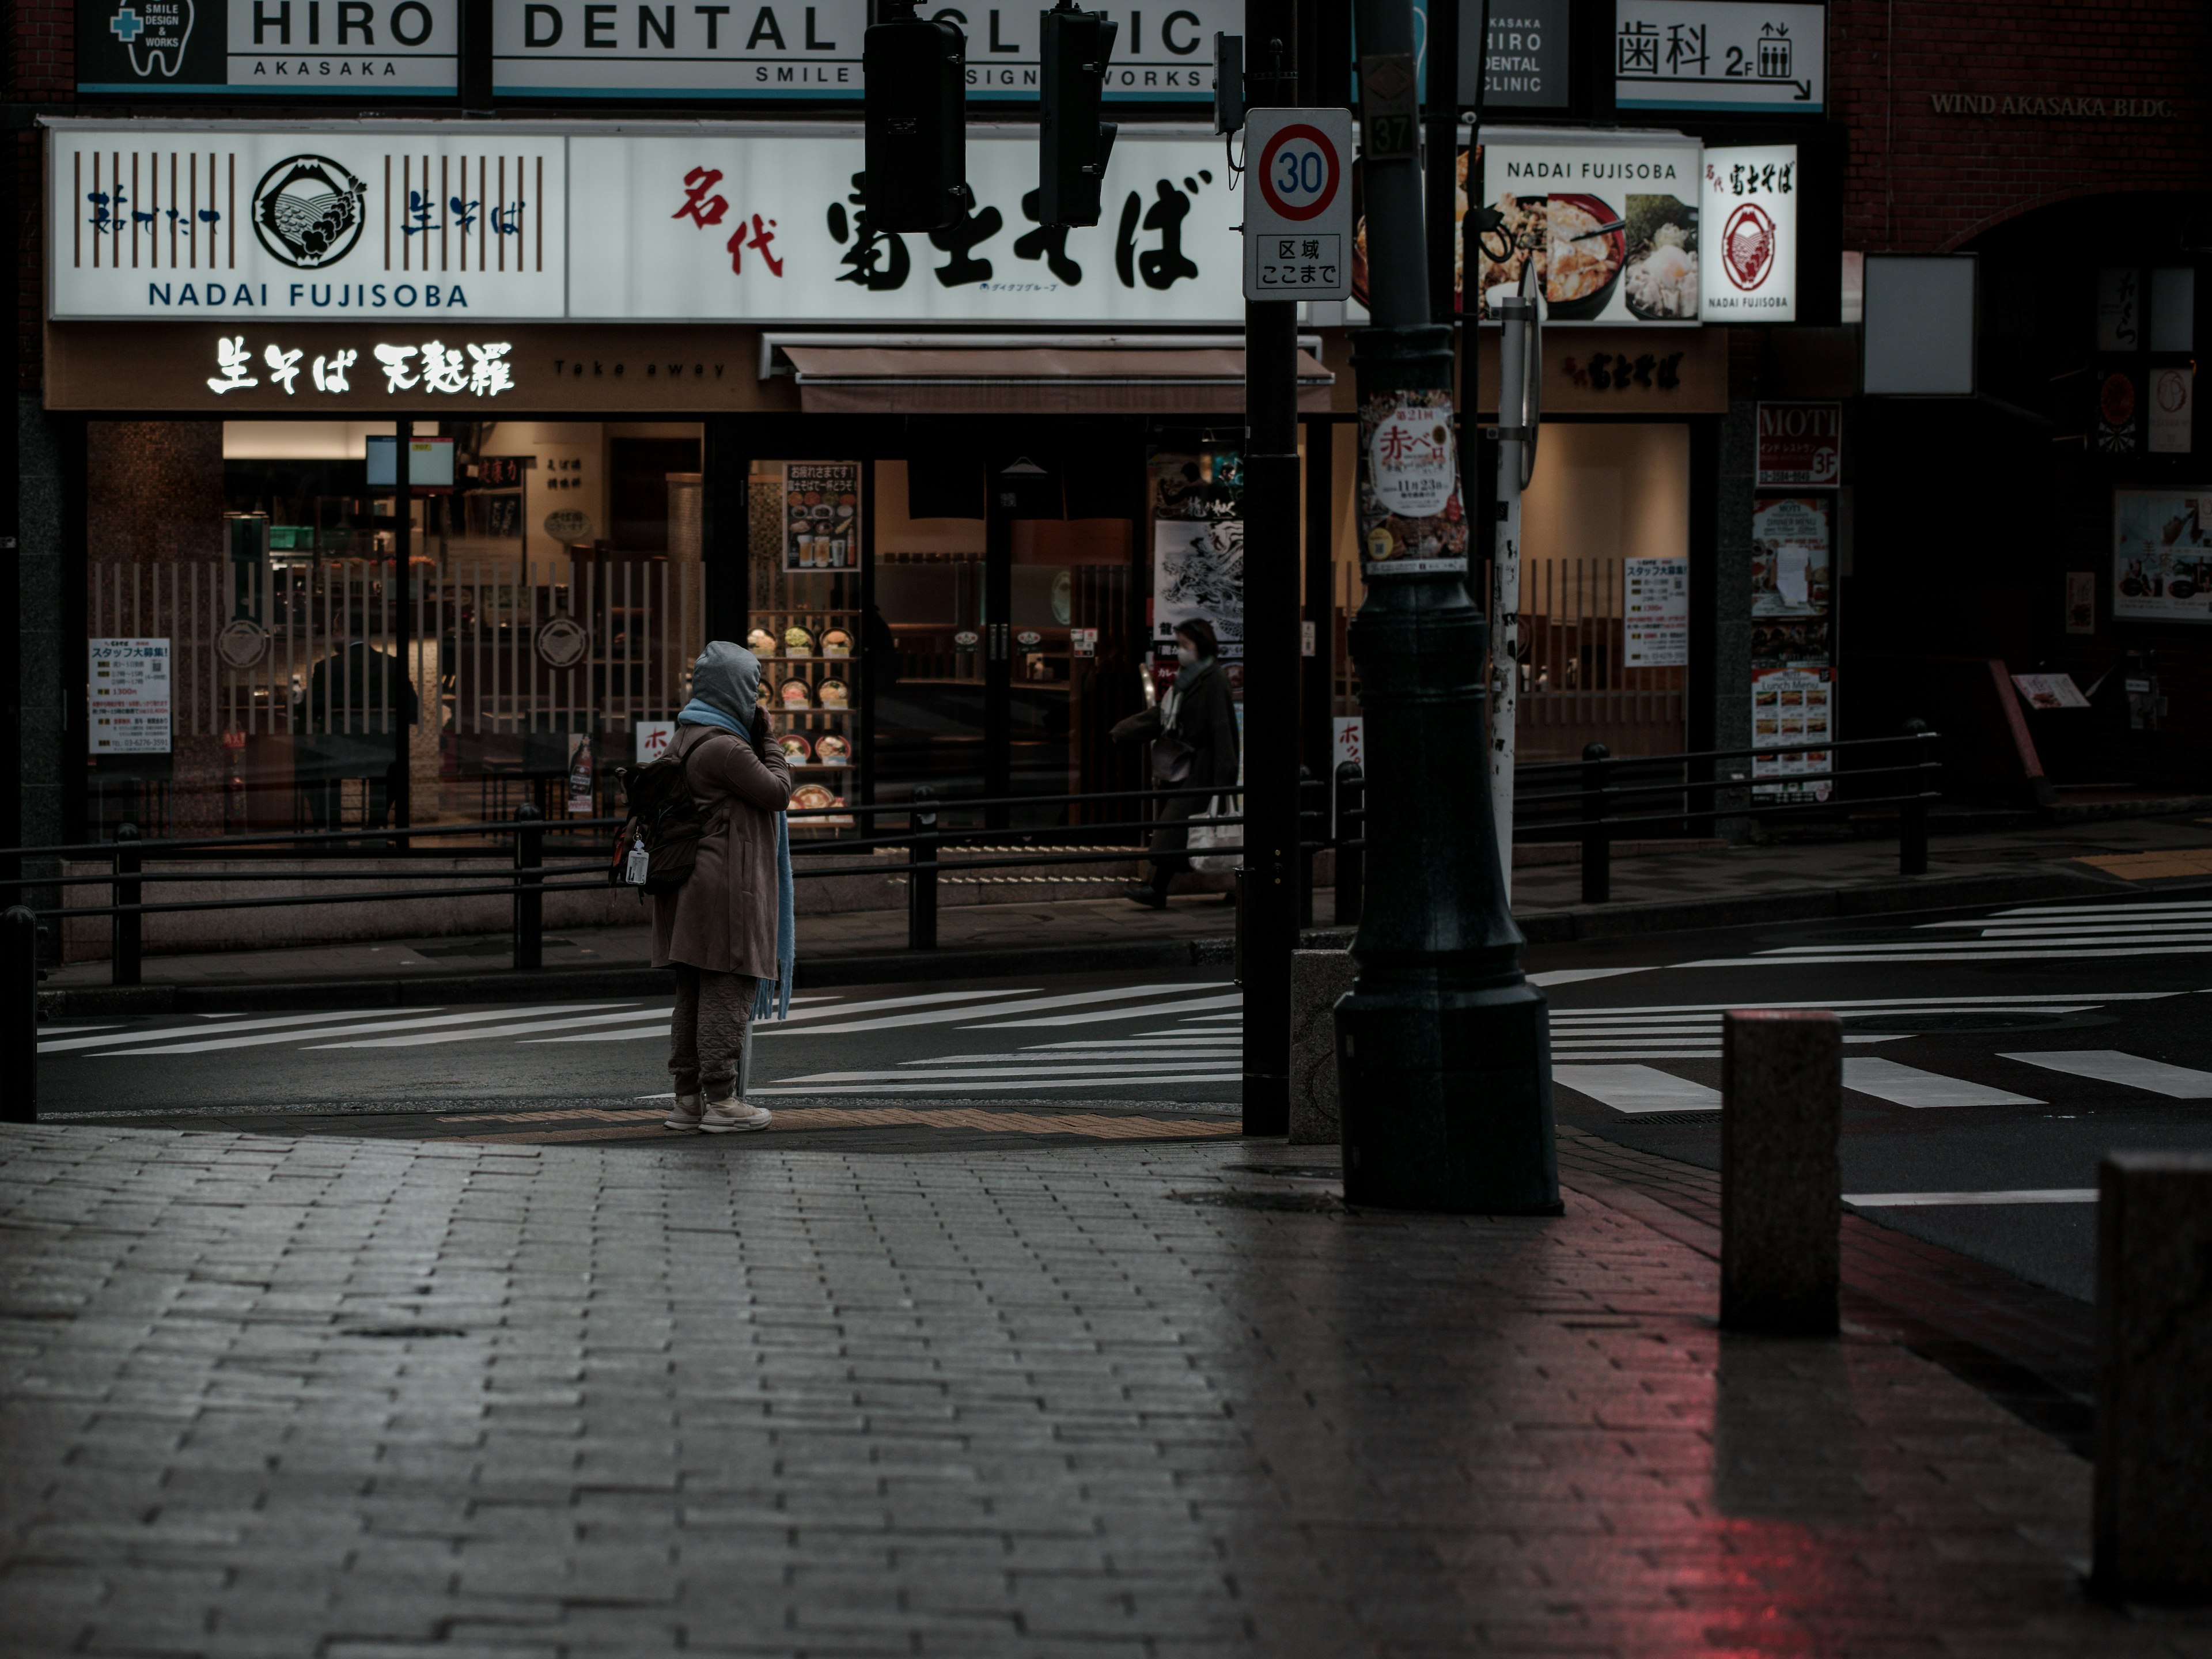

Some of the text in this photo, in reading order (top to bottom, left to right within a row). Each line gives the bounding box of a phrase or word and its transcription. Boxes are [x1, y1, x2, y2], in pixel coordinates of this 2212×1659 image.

[144, 3, 180, 14] SMILE
[145, 16, 179, 26] DESIGN
[158, 26, 166, 36] &
[253, 0, 433, 46] HIRO
[524, 4, 836, 51] DENTAL
[1488, 18, 1541, 29] KASAKA
[145, 37, 180, 48] WORKS
[1618, 21, 1753, 76] 歯科 2F
[253, 61, 397, 77] AKASAKA
[756, 66, 850, 82] SMILE
[966, 70, 1037, 85] SIGN
[1930, 93, 2179, 118] WIND AKASAKA BLDG.
[1375, 116, 1409, 153] 37
[1278, 152, 1322, 193] 30
[1508, 162, 1676, 179] NADAI FUJISOBA
[1729, 159, 1796, 196] 富士そば
[88, 184, 525, 235] 茹でたて 生そば
[671, 166, 783, 278] 名代
[1279, 240, 1320, 260] 区域
[1262, 265, 1336, 284] ここまで
[149, 282, 469, 308] NADAI FUJISOBA
[1708, 297, 1789, 308] NADAI FUJISOBA
[207, 335, 358, 396] 生そば
[554, 361, 724, 376] Take away
[1588, 352, 1685, 388] 富士そば
[1760, 408, 1838, 437] MOTI
[1815, 452, 1836, 474] 3F
